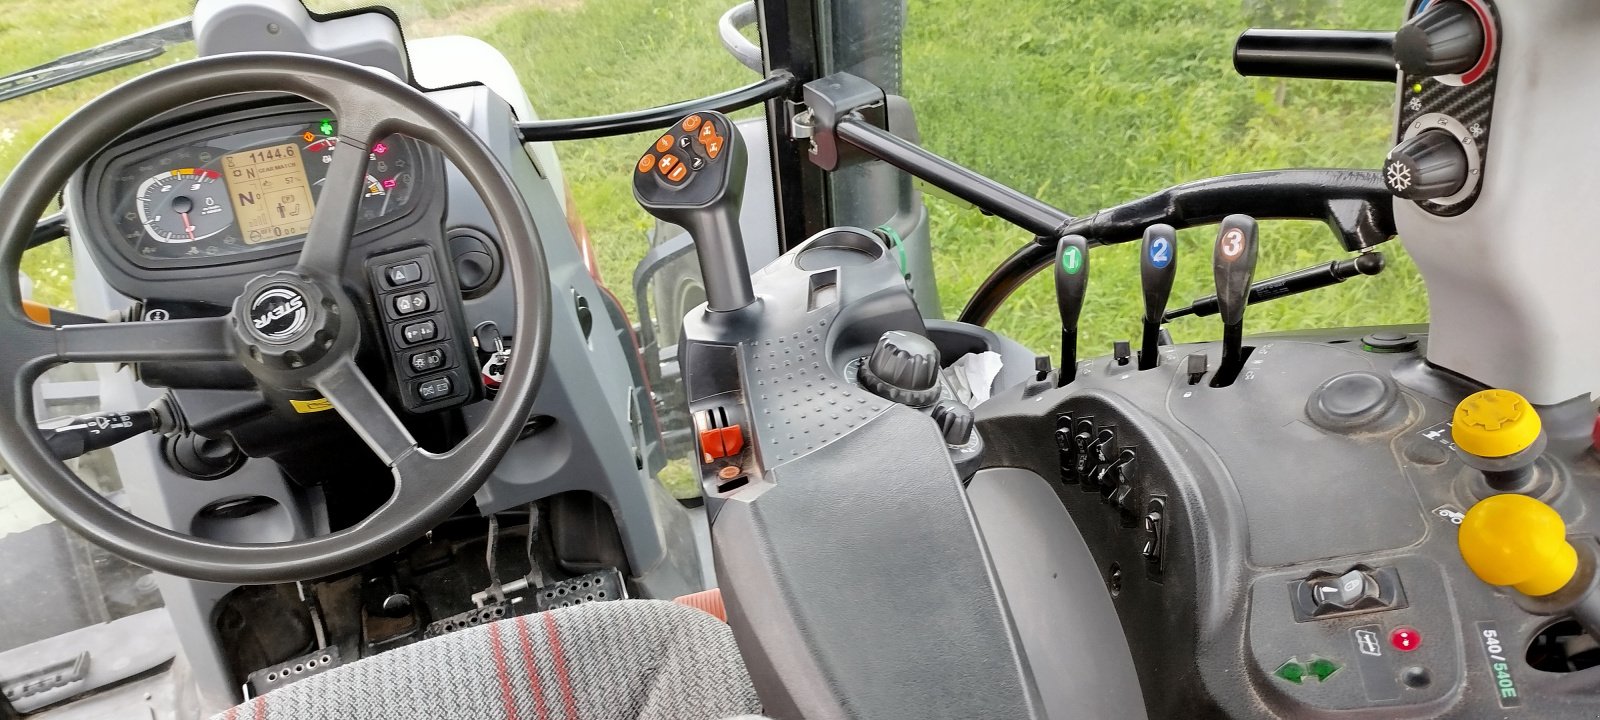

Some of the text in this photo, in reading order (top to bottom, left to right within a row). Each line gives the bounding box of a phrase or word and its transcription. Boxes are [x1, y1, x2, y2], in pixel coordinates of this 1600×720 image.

[249, 146, 295, 163] 1144.6
[246, 168, 255, 179] N
[238, 191, 255, 207] N
[1152, 238, 1168, 262] 2
[1223, 231, 1242, 256] 3
[1063, 250, 1076, 269] 1
[252, 295, 303, 329] STEYR
